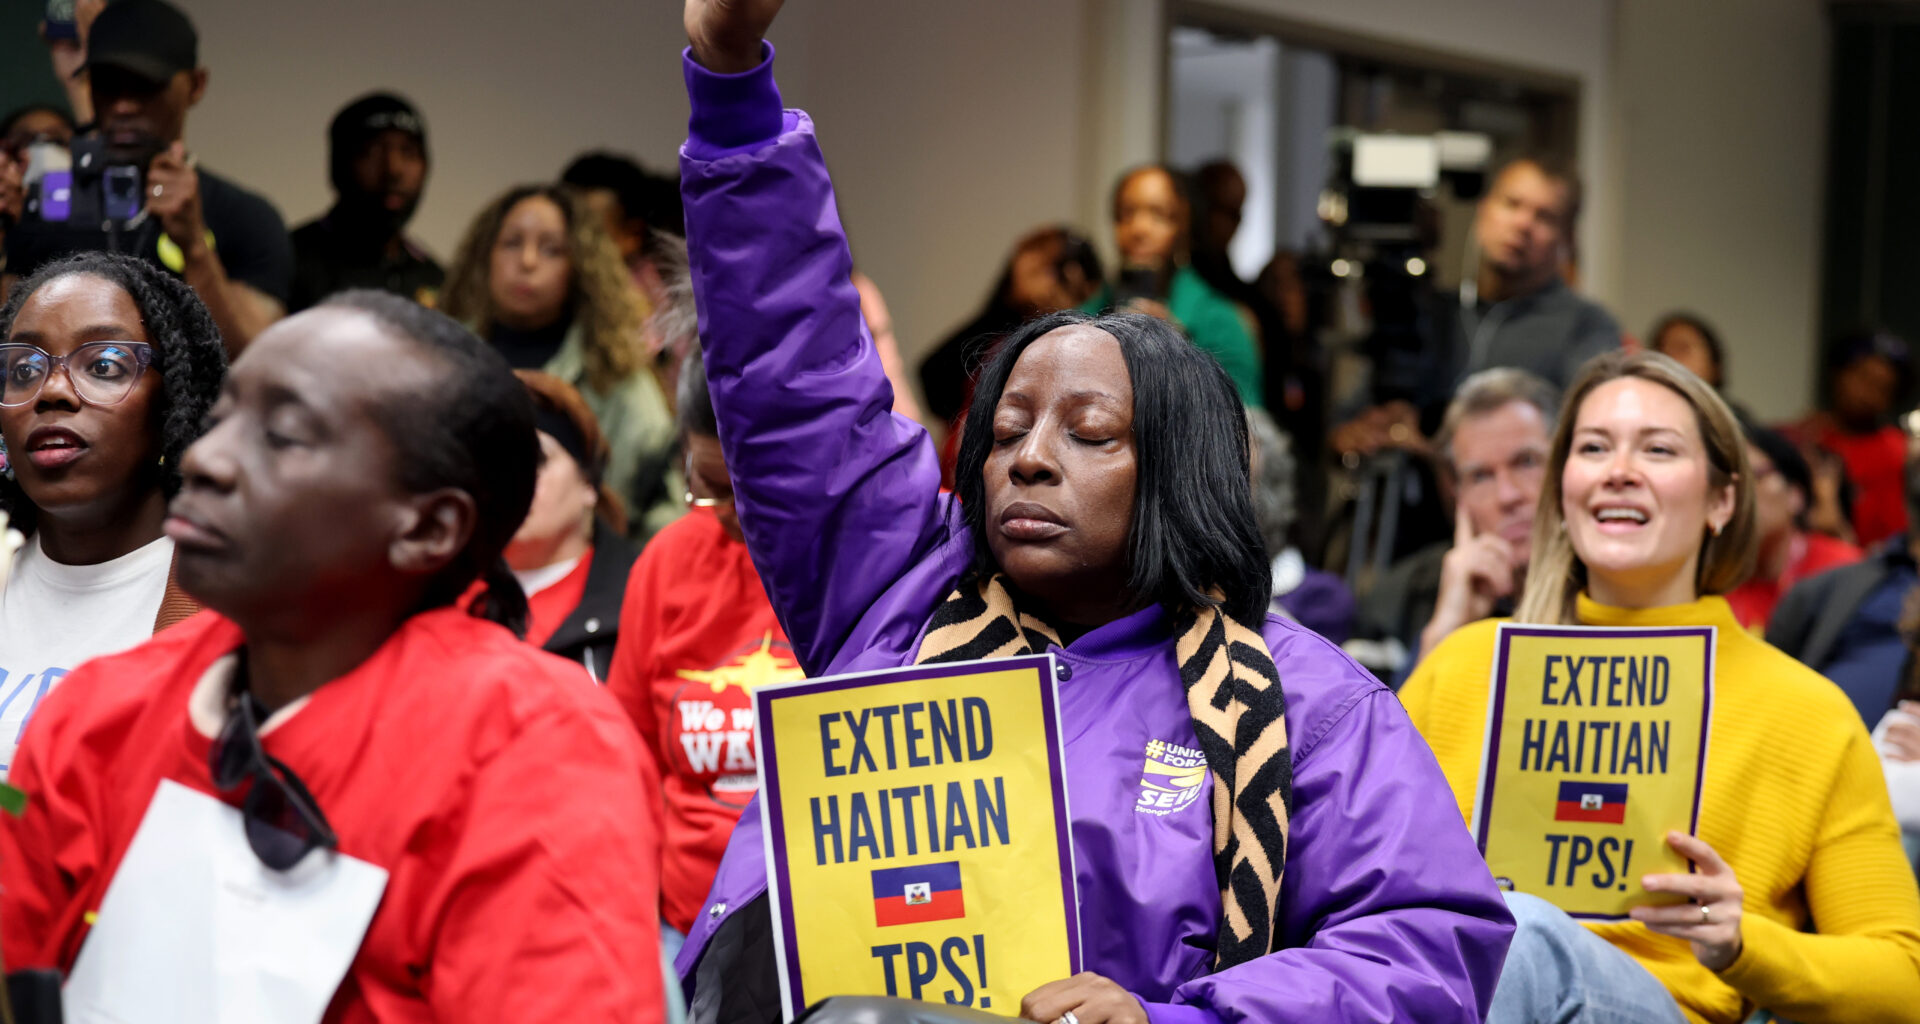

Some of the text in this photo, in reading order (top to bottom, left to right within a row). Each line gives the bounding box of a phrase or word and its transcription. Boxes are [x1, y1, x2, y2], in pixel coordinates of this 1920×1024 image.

[1542, 655, 1669, 706] EXTEND
[678, 700, 726, 731] We
[819, 697, 993, 777] EXTEND
[1520, 719, 1670, 774] HAITIAN
[810, 776, 1010, 865] HAITIAN
[1545, 834, 1633, 891] TPS!
[871, 934, 991, 1008] TPS!
